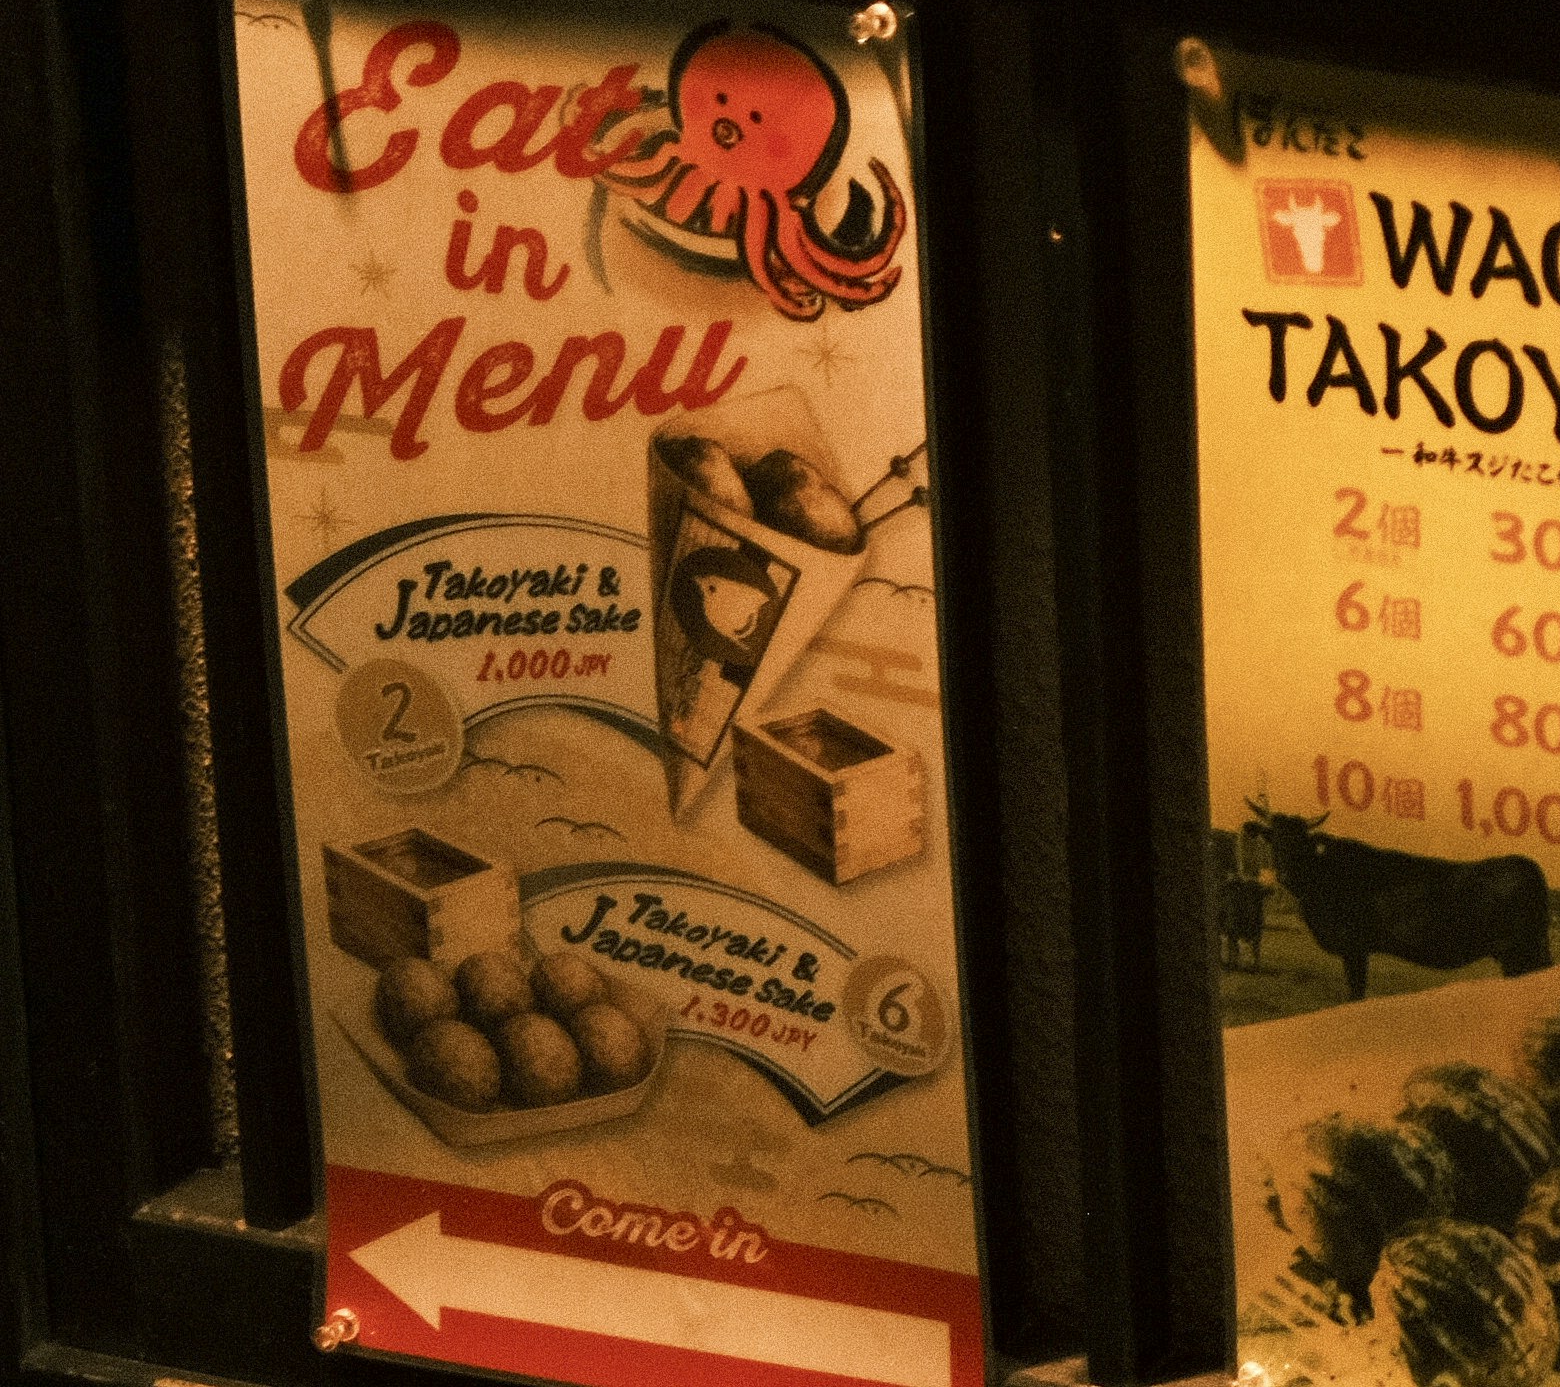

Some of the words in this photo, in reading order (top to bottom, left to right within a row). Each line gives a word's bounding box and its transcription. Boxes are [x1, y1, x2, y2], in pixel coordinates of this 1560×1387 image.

[294, 19, 645, 195] Eat
[444, 189, 569, 303] in
[278, 315, 750, 461] Menu
[1333, 486, 1421, 549] 2個
[375, 579, 559, 642] Japanese
[566, 601, 643, 637] Sake
[423, 560, 589, 605] Takoyaki
[598, 568, 620, 596] &
[1334, 580, 1421, 641] 6個
[381, 682, 416, 743] 2
[1334, 669, 1424, 732] 8個
[1311, 755, 1425, 822] 10個
[561, 894, 753, 994] Japanese
[755, 973, 836, 1024] Sake
[628, 892, 784, 968] Takoyaki
[797, 951, 820, 982] &
[878, 983, 909, 1032] 6
[542, 1189, 700, 1253] Come
[707, 1211, 770, 1265] in
